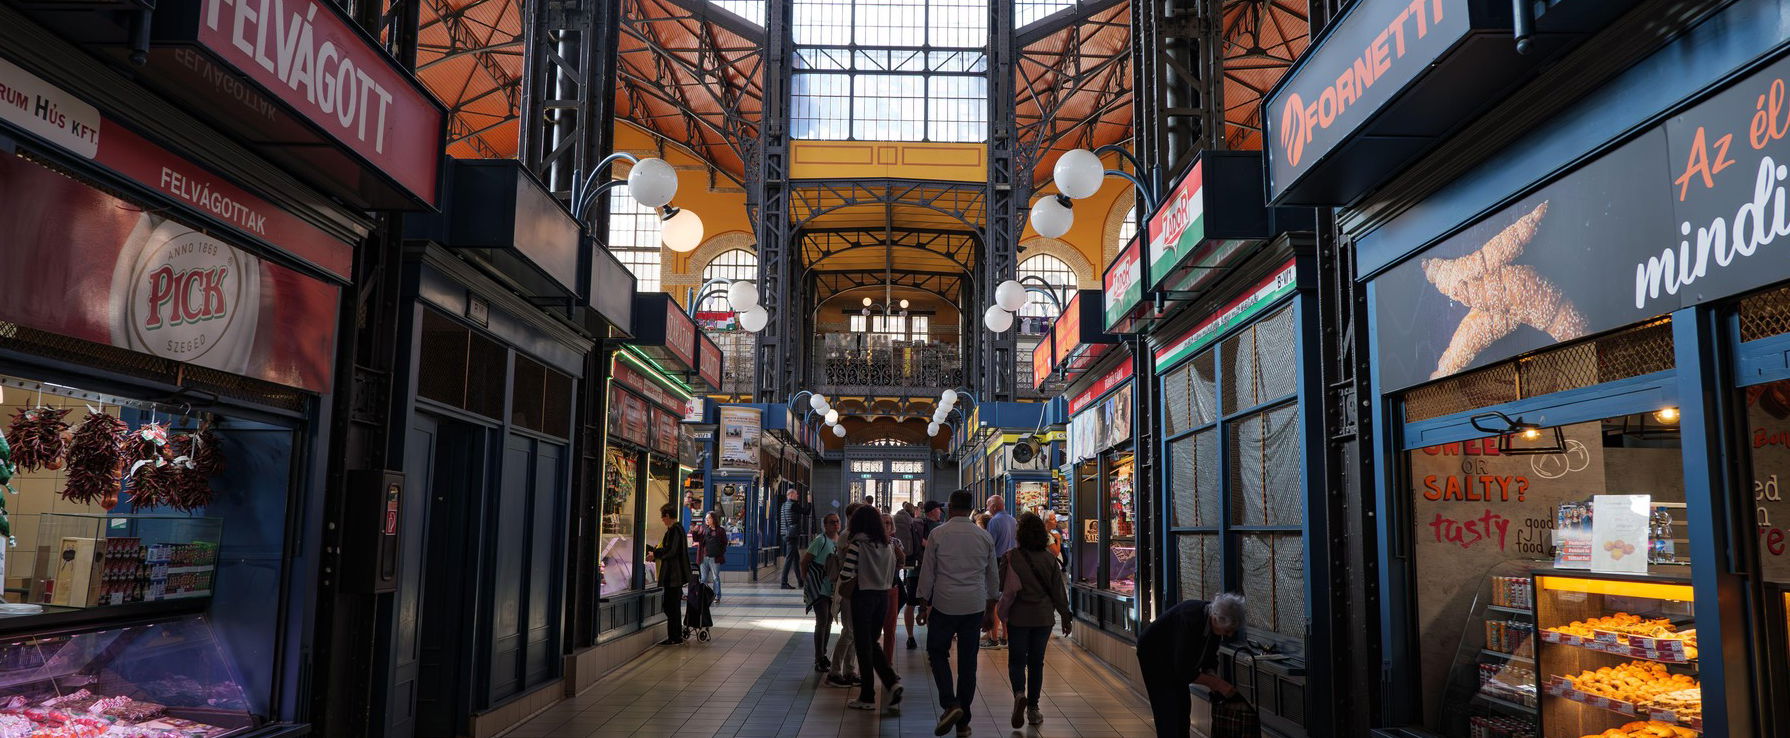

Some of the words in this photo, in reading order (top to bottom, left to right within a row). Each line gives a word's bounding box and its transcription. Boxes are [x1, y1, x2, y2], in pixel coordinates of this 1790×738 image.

[1304, 0, 1444, 145] FORNETTI
[1674, 126, 1736, 202] Az
[1750, 78, 1790, 150] él
[160, 166, 266, 236] FELVÁGOTTAK
[168, 243, 194, 260] ANNO
[198, 242, 218, 257] 1869
[145, 266, 228, 330] PICK
[167, 334, 206, 353] SZEGED
[1462, 458, 1489, 474] OR
[1423, 475, 1529, 502] SALTY?
[1429, 508, 1510, 552] tasty
[1516, 529, 1544, 553] food
[1525, 507, 1554, 542] good
